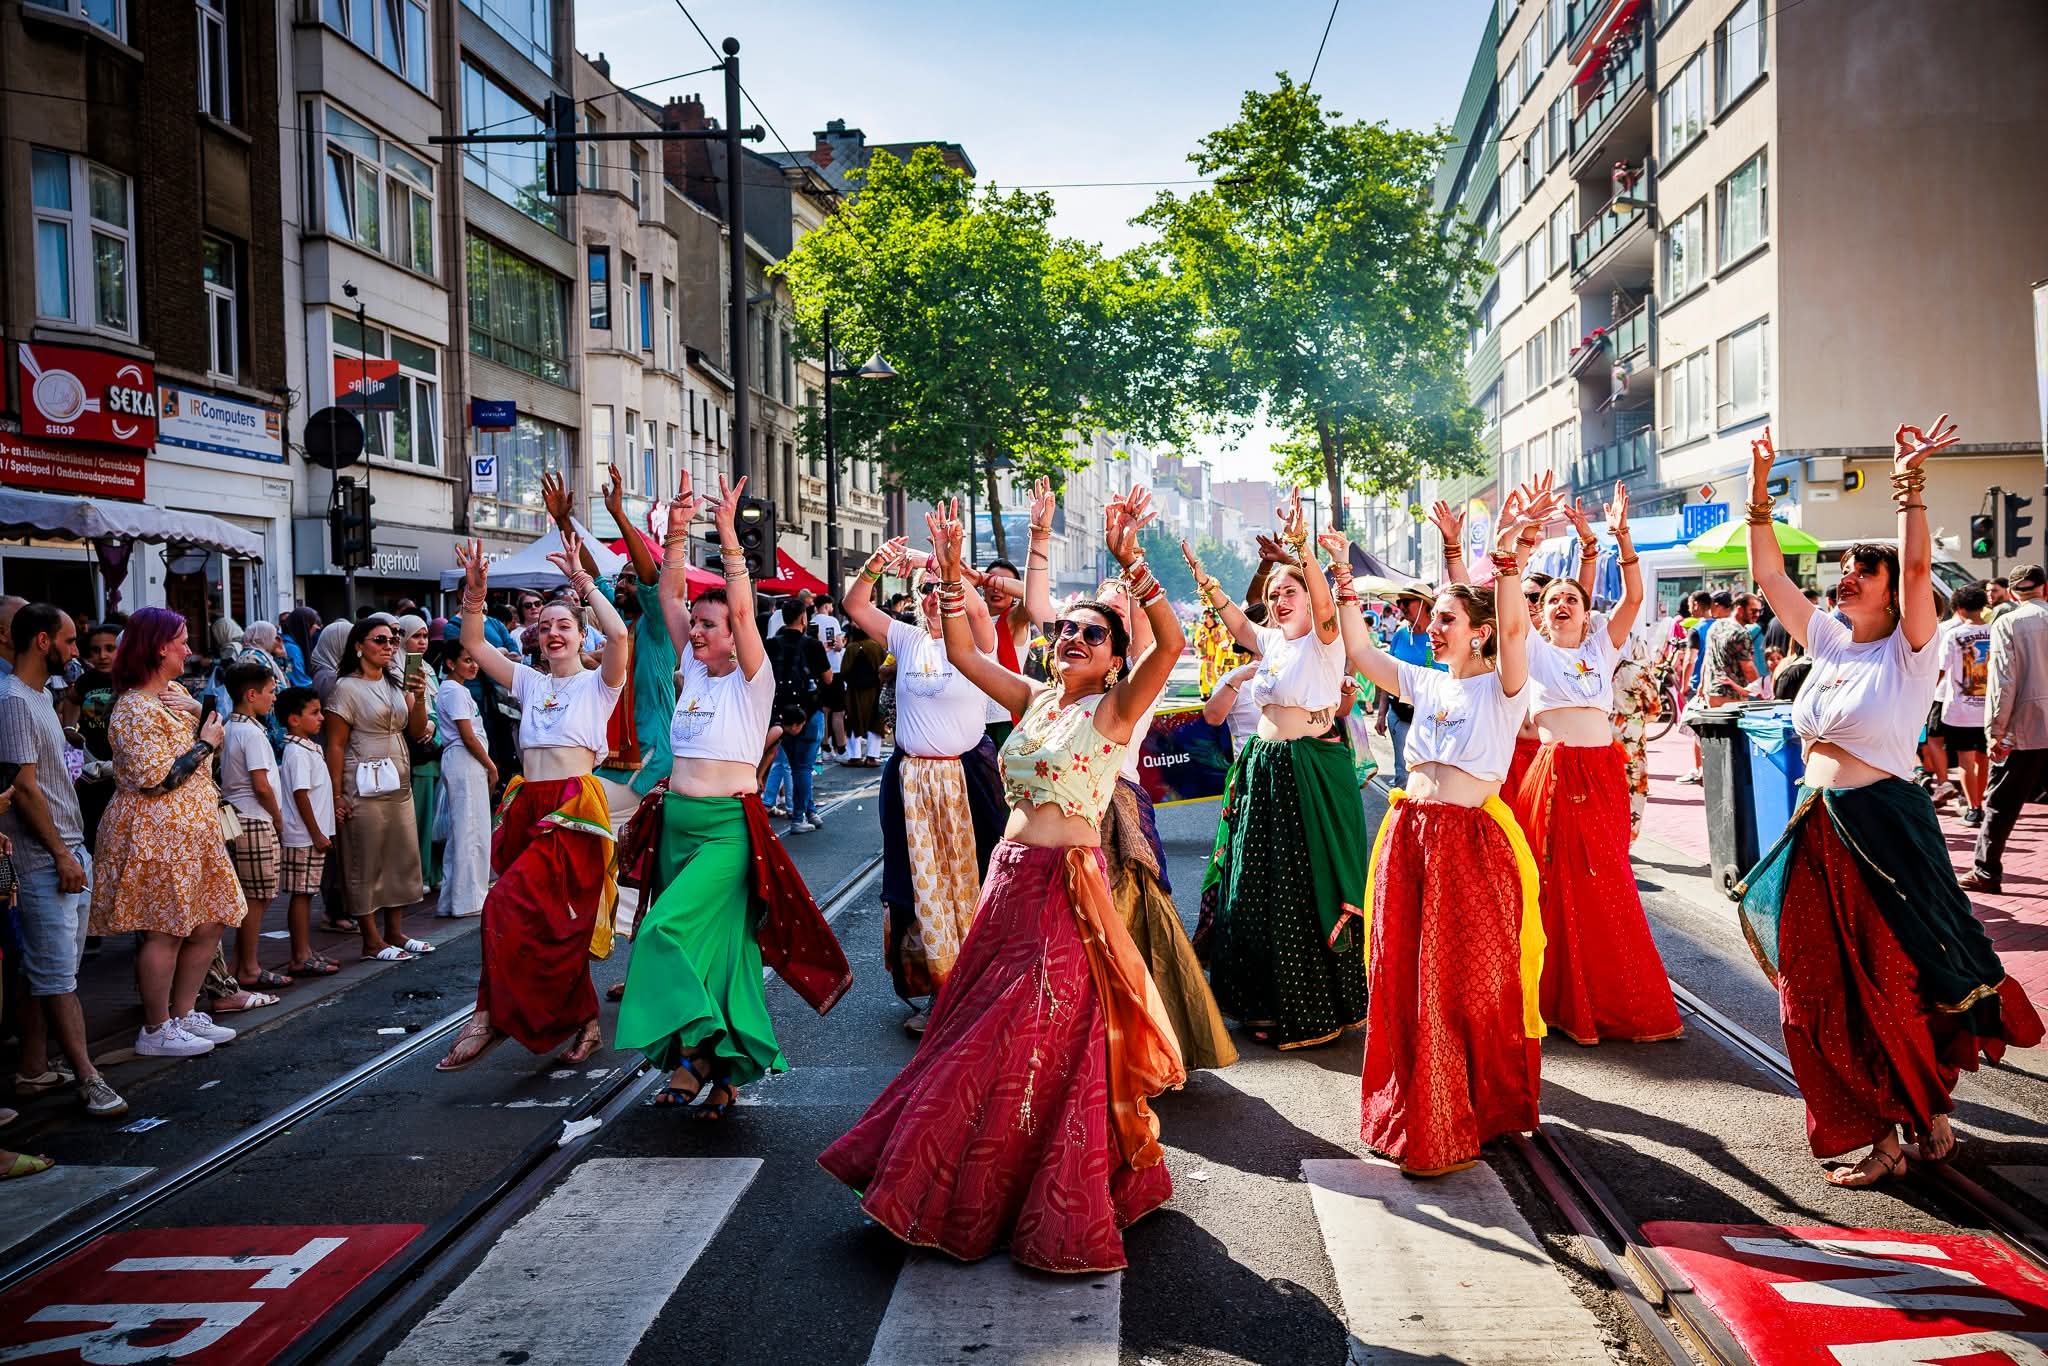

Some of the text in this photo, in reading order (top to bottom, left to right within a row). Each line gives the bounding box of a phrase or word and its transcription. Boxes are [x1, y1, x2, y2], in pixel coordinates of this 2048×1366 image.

[190, 399, 256, 428] IRComputers
[46, 424, 75, 435] SHOP
[10, 460, 50, 476] Speelgoed
[56, 466, 135, 486] Onderhoudsproducten
[11, 447, 21, 456] en
[99, 458, 140, 475] Gereedschap
[370, 549, 421, 575] orgerhout
[1143, 752, 1190, 768] Quipus
